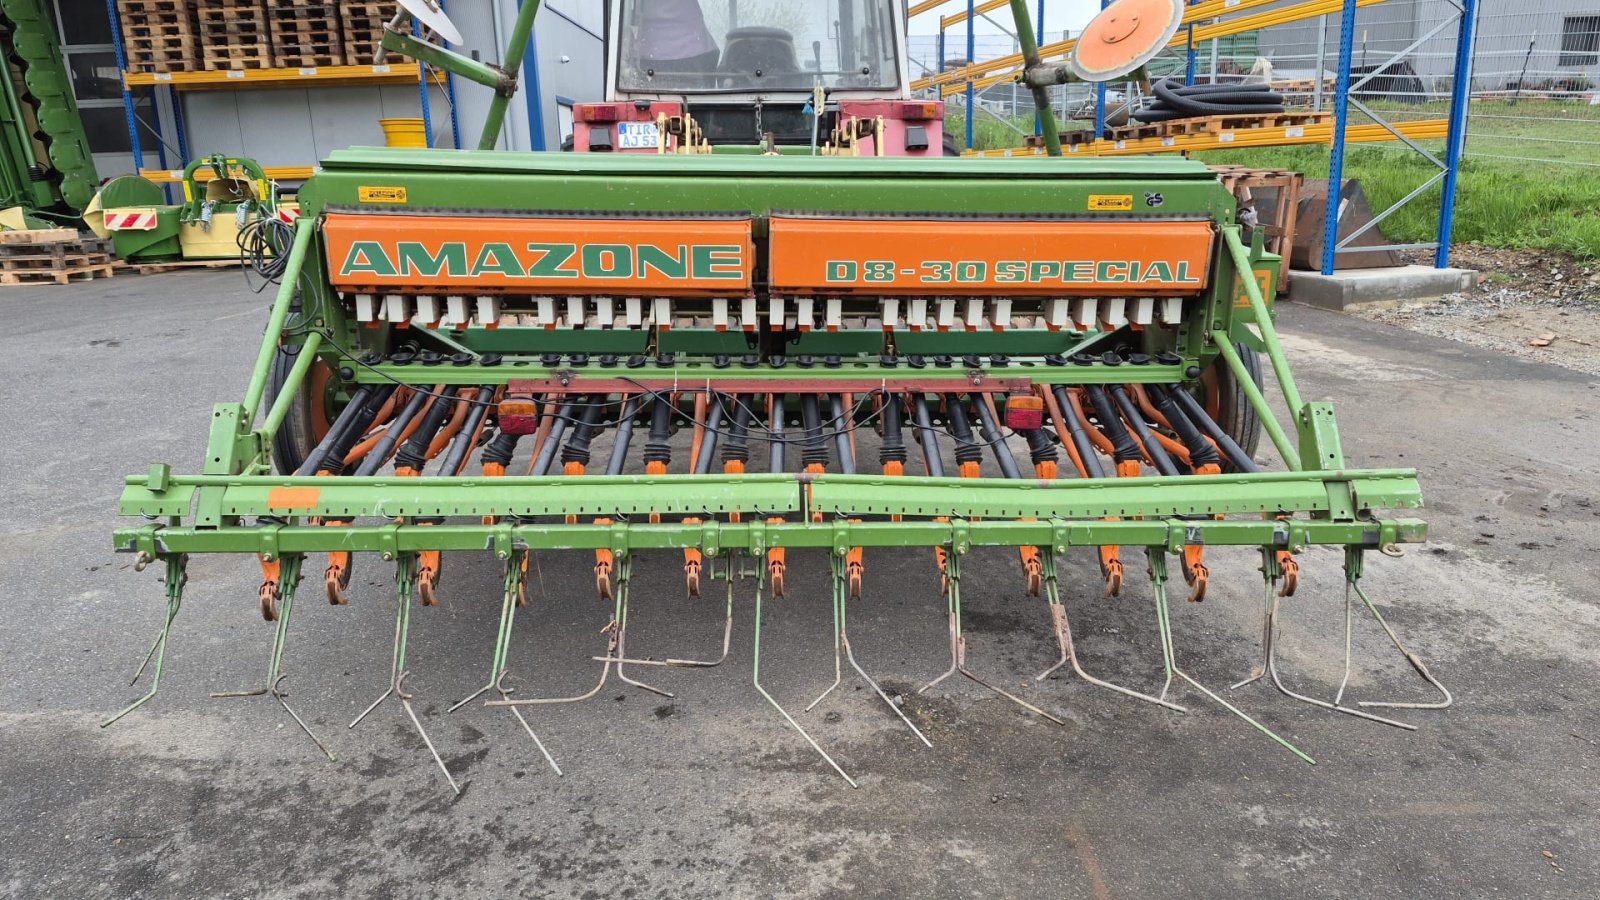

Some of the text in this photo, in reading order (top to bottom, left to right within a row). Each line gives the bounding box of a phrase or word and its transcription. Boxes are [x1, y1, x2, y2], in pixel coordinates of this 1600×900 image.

[626, 124, 651, 135] TIR
[622, 136, 638, 147] AJ
[339, 241, 743, 279] AMAZONE
[994, 260, 1200, 283] SPECIAL
